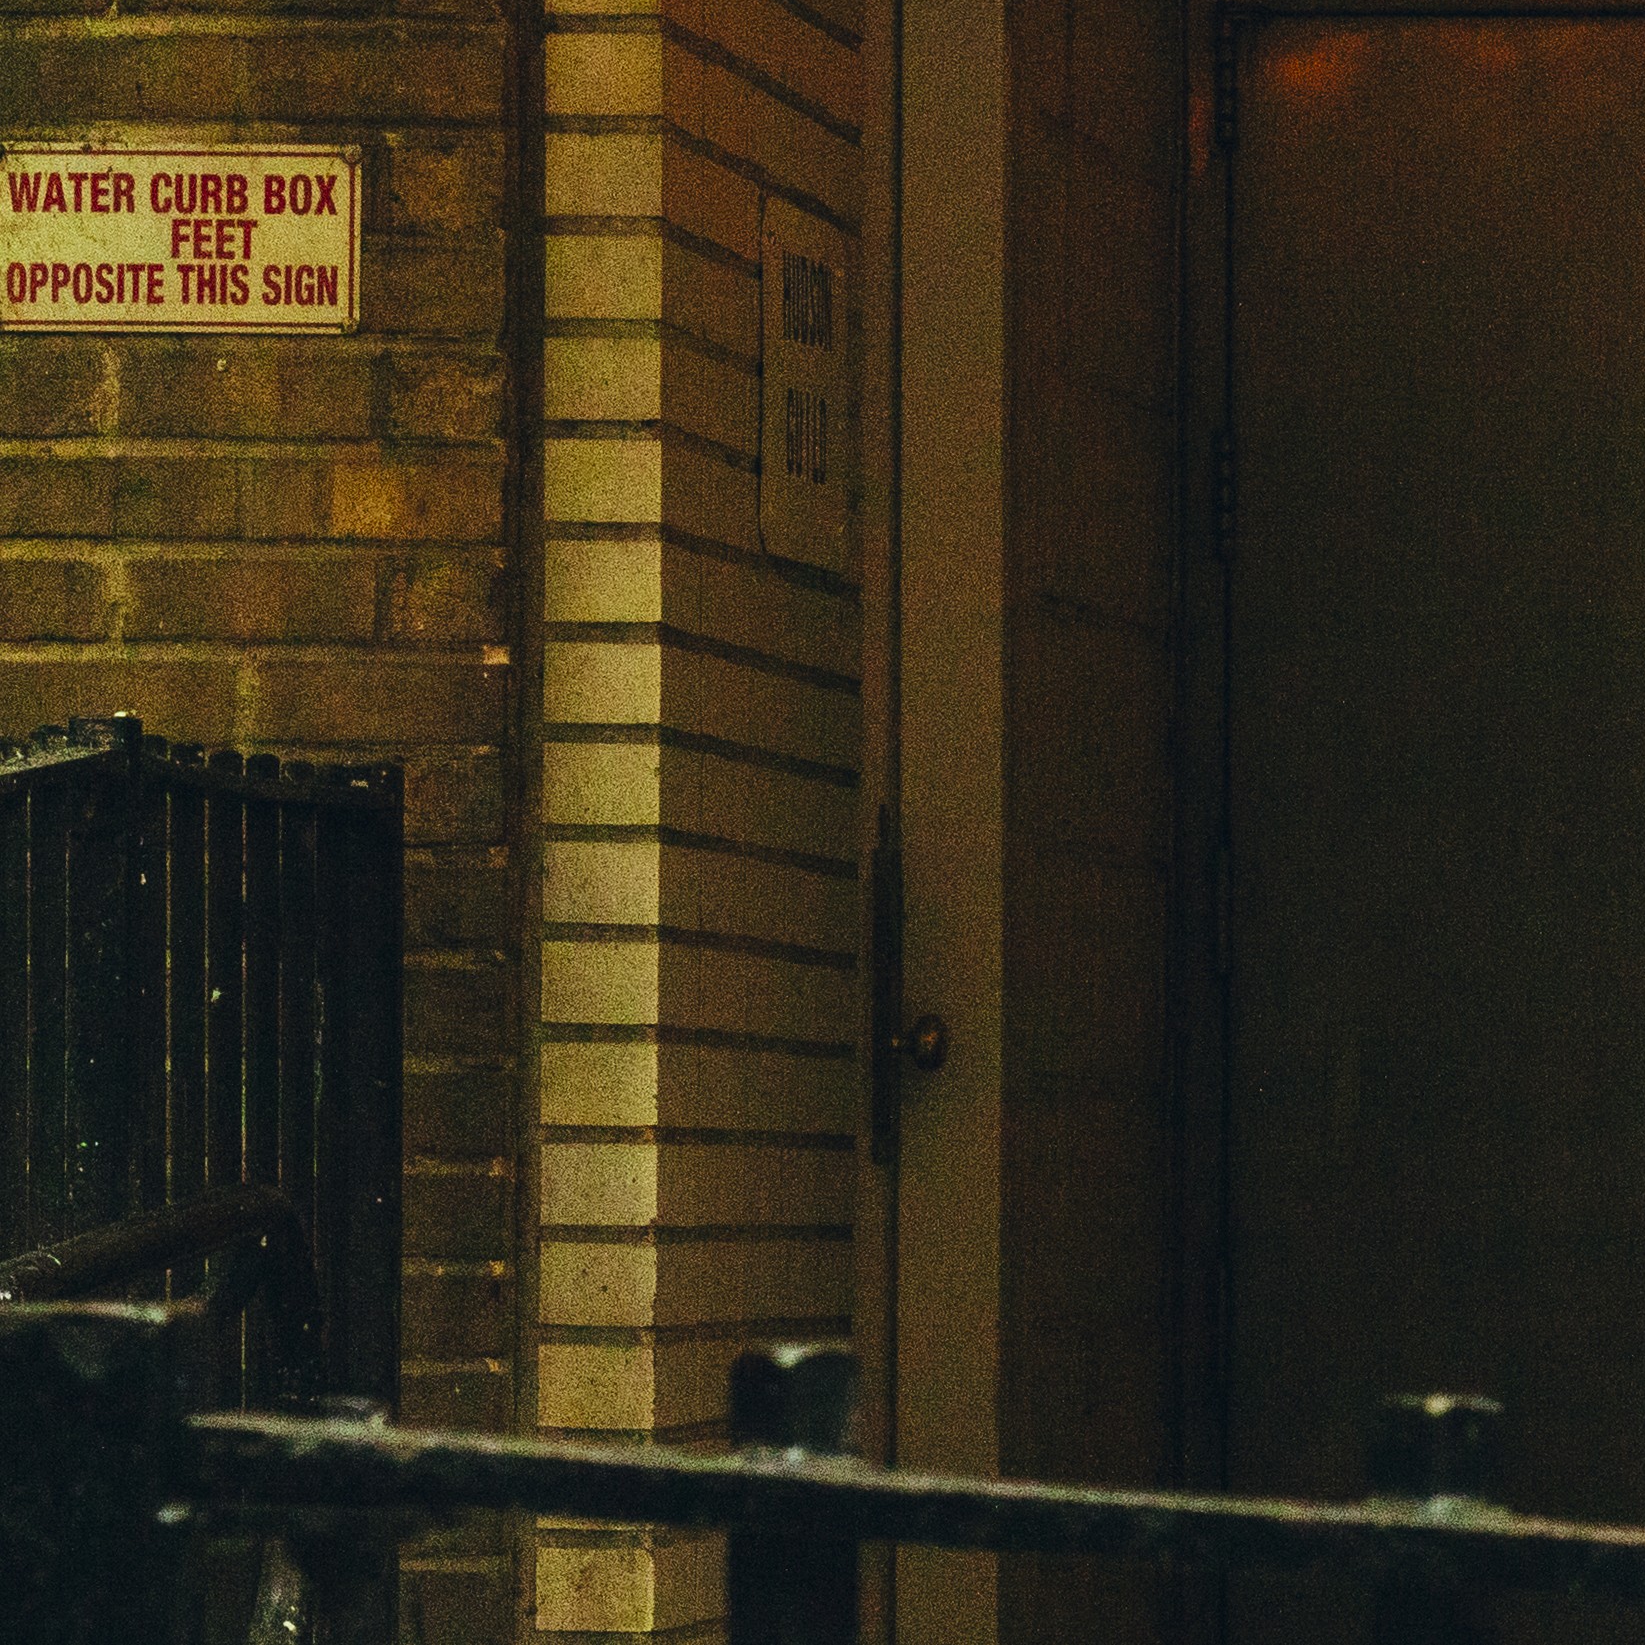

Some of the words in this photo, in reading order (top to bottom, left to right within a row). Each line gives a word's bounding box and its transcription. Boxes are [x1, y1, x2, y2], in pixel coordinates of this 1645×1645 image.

[7, 172, 136, 213] WATER
[150, 173, 249, 215] CURB
[263, 174, 338, 216] BOX
[171, 219, 258, 260] FEET
[6, 262, 164, 304] OPPOSITE
[176, 264, 249, 305] THIS
[262, 265, 338, 307] SIGN
[783, 250, 832, 350] HUDSON
[787, 387, 827, 484] GUILD
